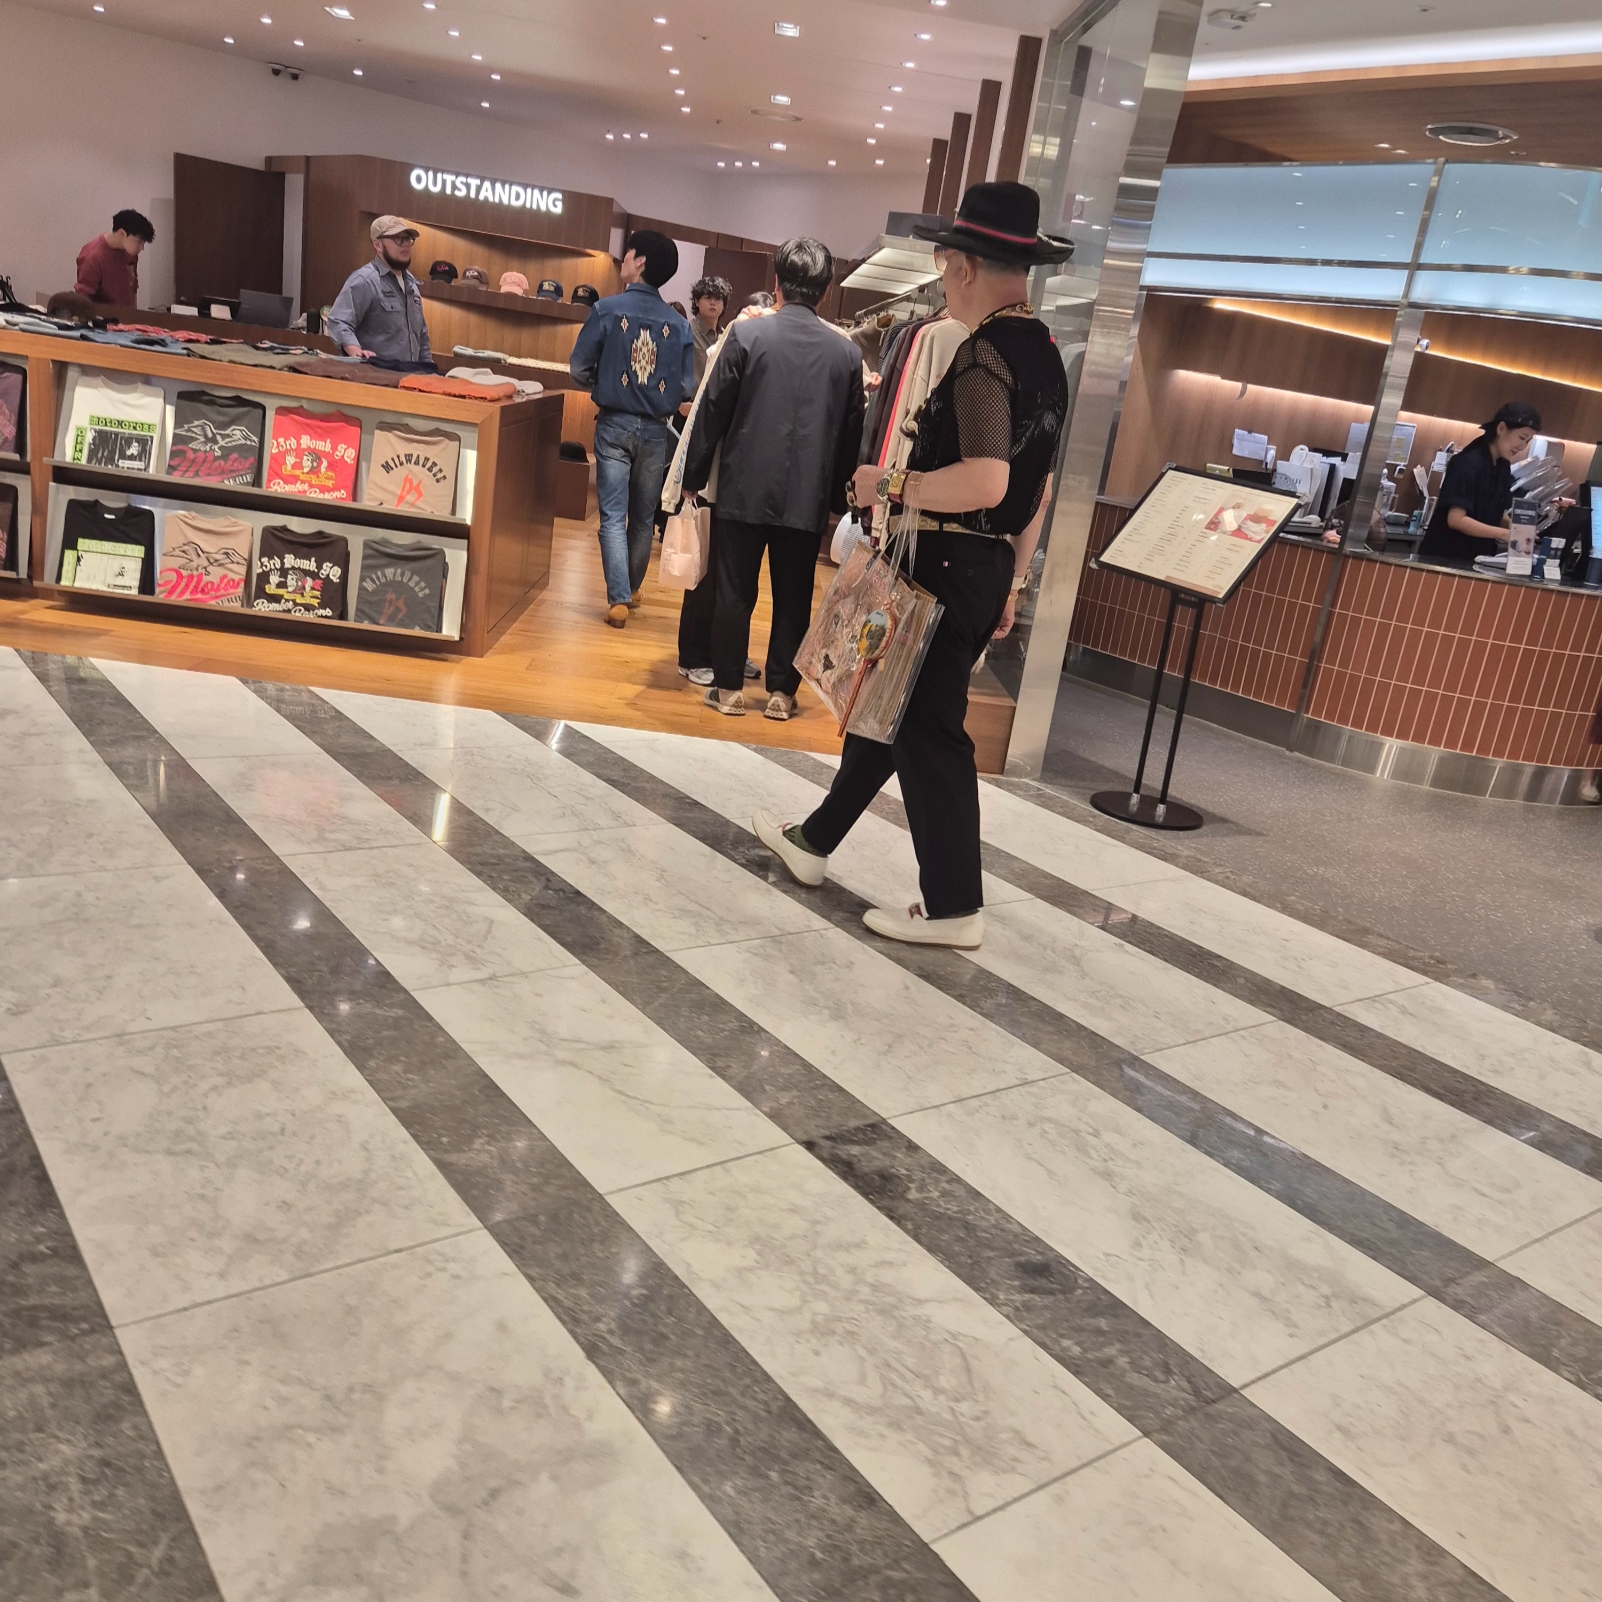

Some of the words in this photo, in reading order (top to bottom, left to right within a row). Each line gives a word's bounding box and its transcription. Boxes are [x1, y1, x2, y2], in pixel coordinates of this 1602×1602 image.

[410, 168, 563, 214] OUTSTANDING
[271, 436, 297, 454] 23rd
[168, 445, 257, 482] Motor
[380, 453, 447, 483] MILWAUKEE
[157, 567, 245, 603] Motor
[362, 568, 430, 597] MILWAUKEE
